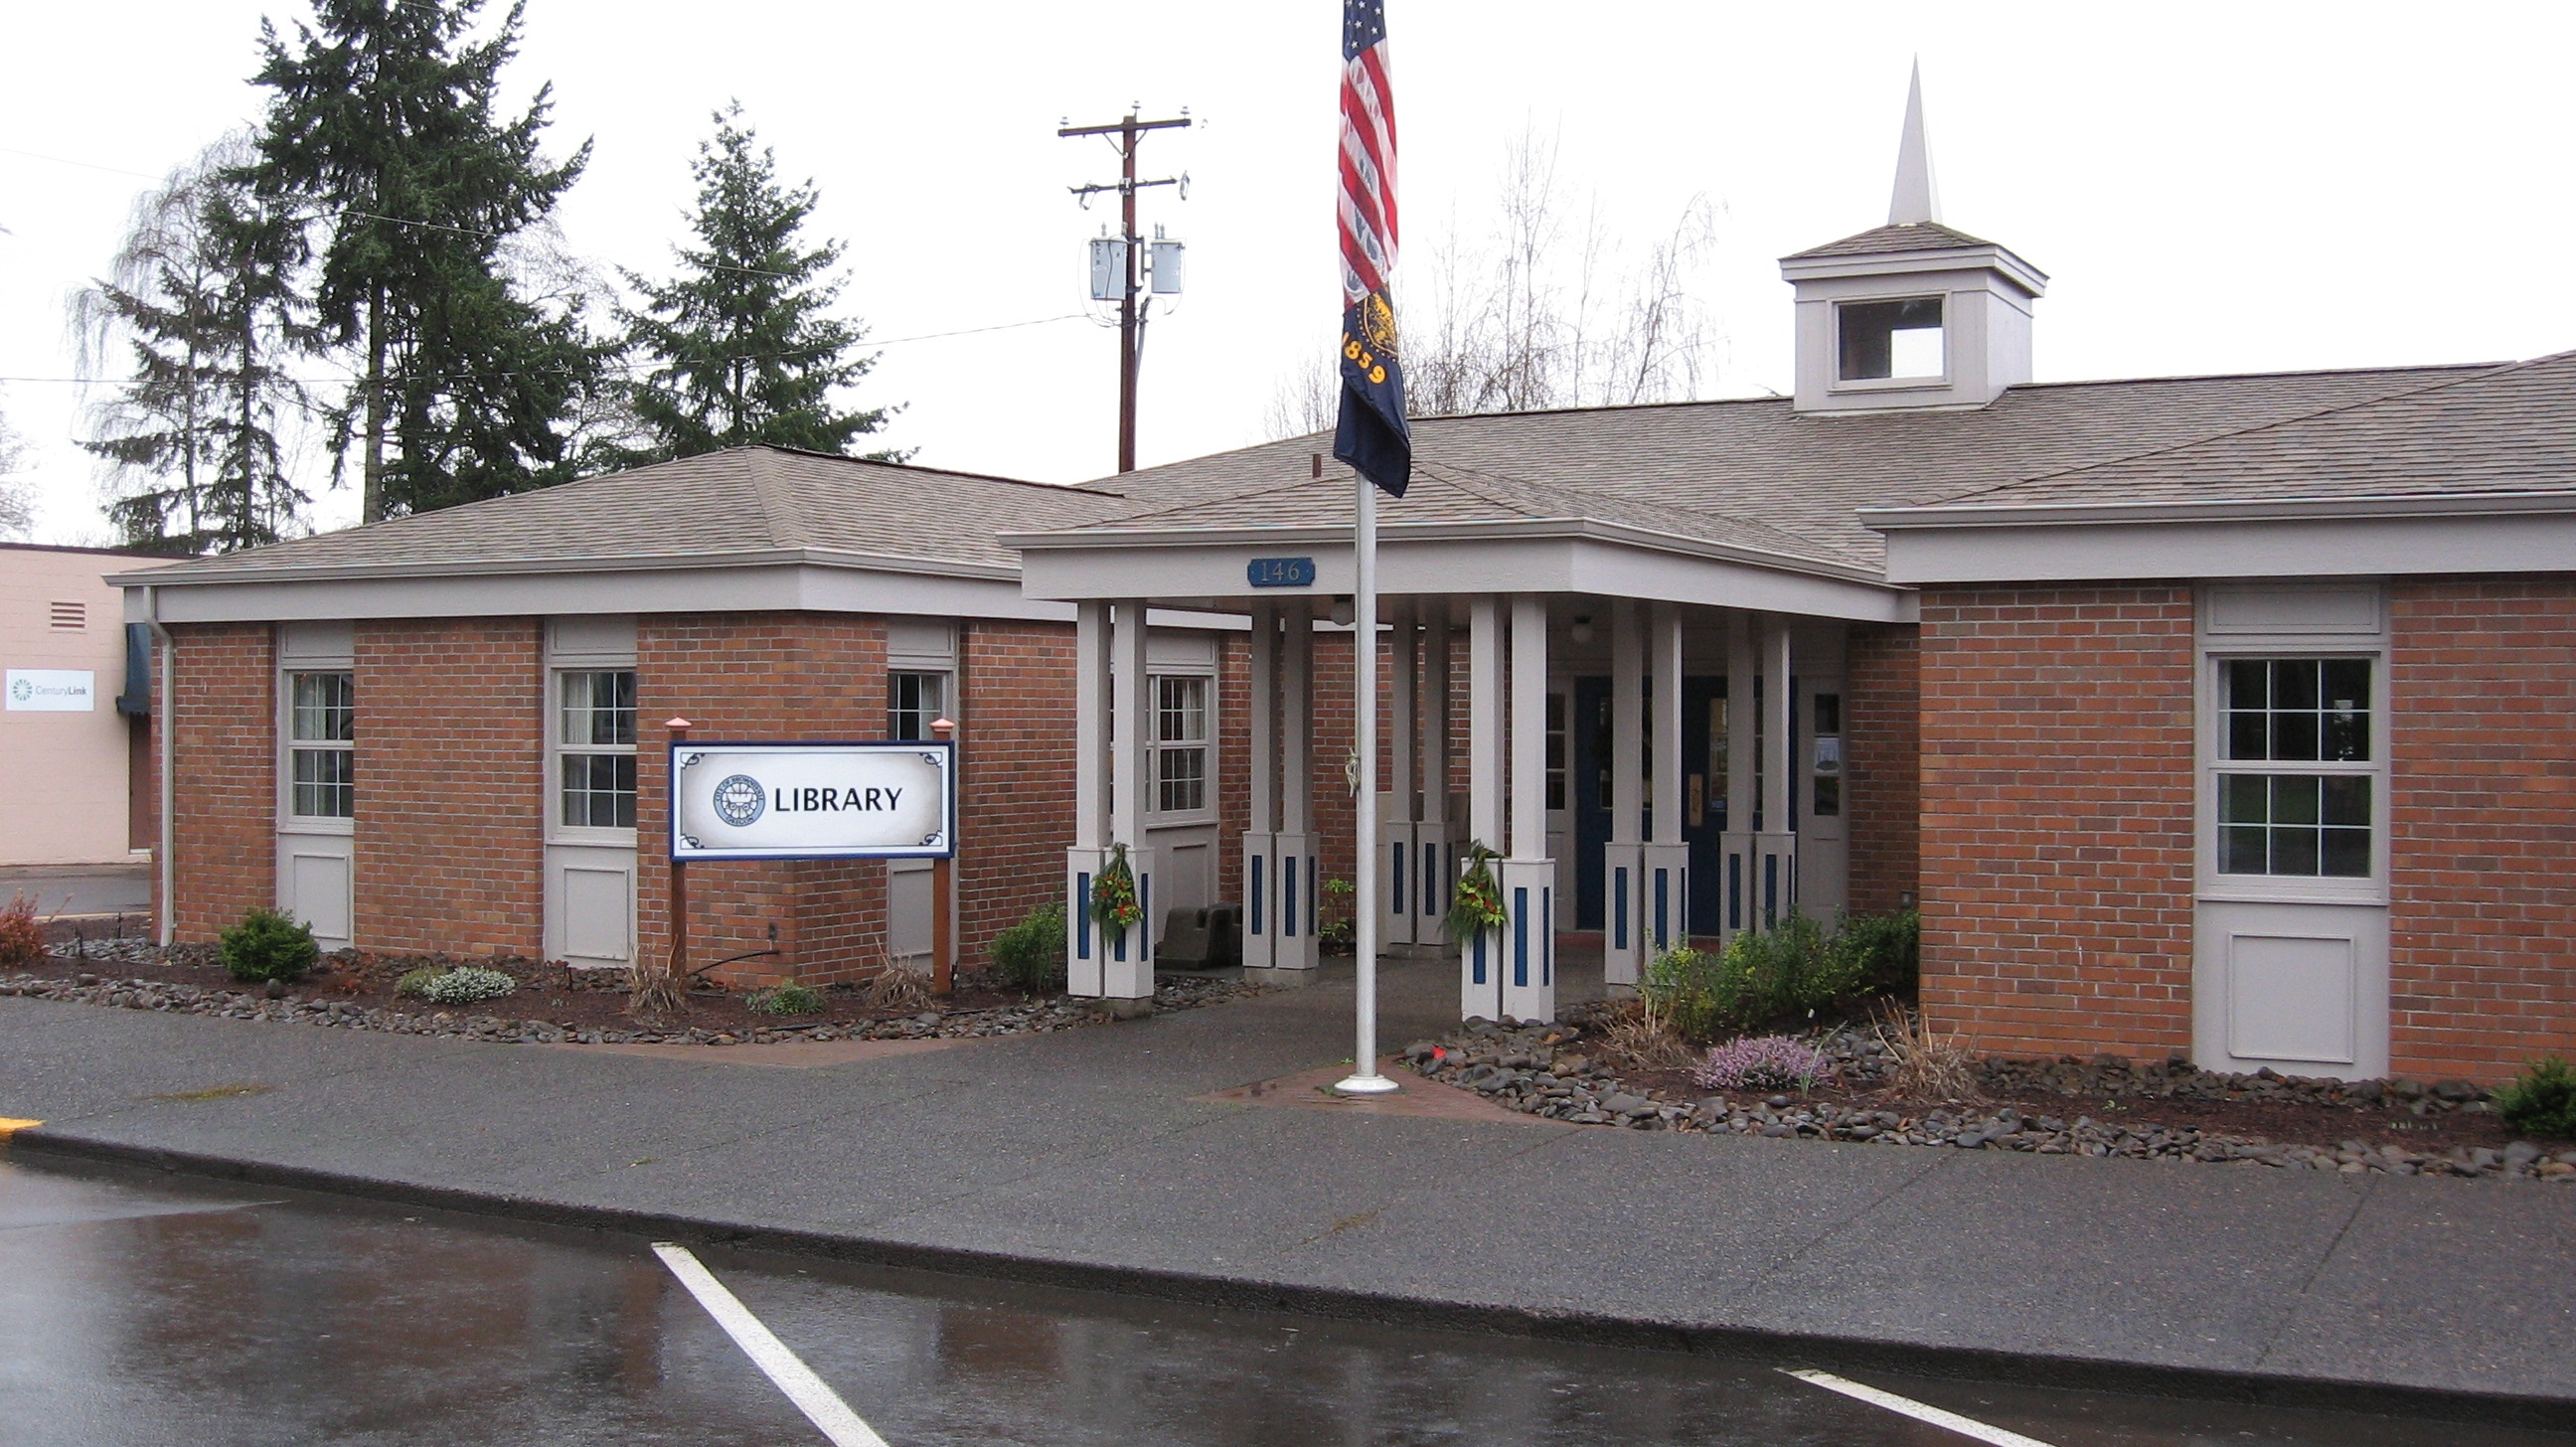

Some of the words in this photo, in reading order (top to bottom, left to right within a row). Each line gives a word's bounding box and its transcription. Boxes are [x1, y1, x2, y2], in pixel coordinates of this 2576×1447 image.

[1261, 562, 1300, 581] 146
[35, 685, 87, 697] CenturyLink
[775, 787, 903, 811] LIBRARY
